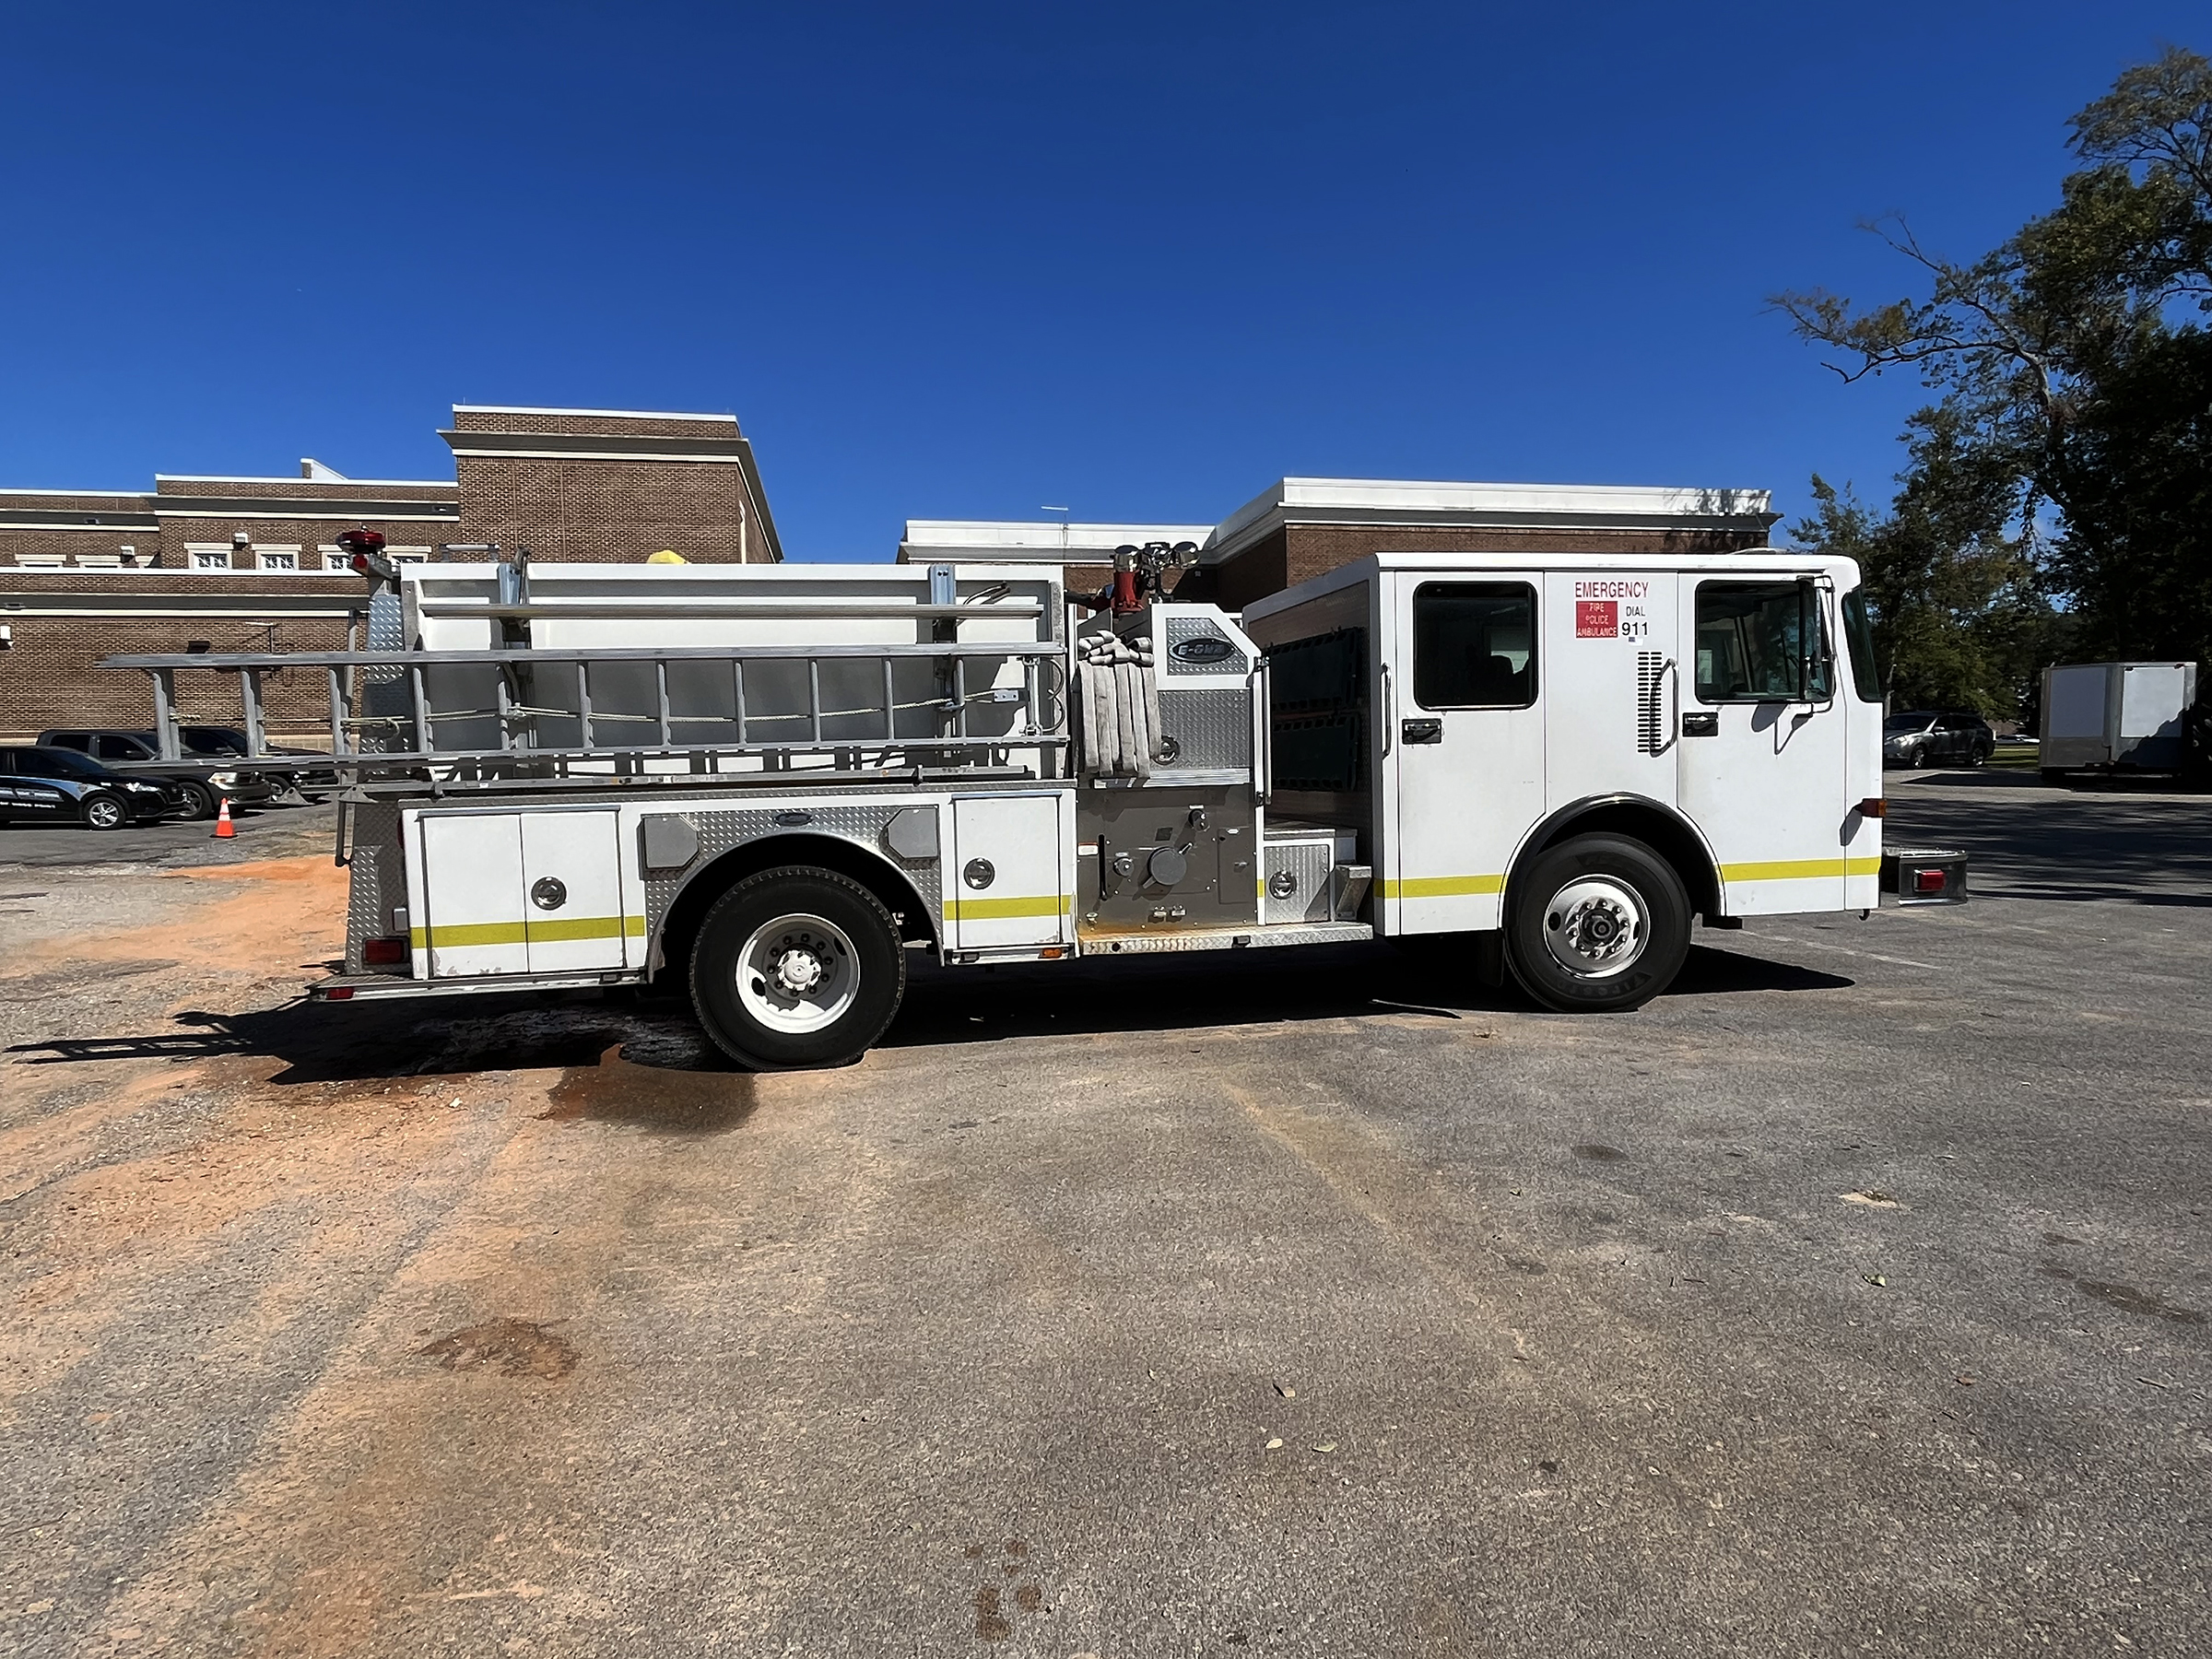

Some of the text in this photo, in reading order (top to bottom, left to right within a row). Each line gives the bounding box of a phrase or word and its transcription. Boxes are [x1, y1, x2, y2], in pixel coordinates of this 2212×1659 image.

[1575, 582, 1649, 598] EMERGENCY
[1589, 603, 1605, 613] FIRE
[1626, 606, 1646, 617] DIAL
[1585, 615, 1609, 625] POLICE
[1577, 627, 1618, 637] AMBULANCE
[1621, 622, 1648, 636] 911
